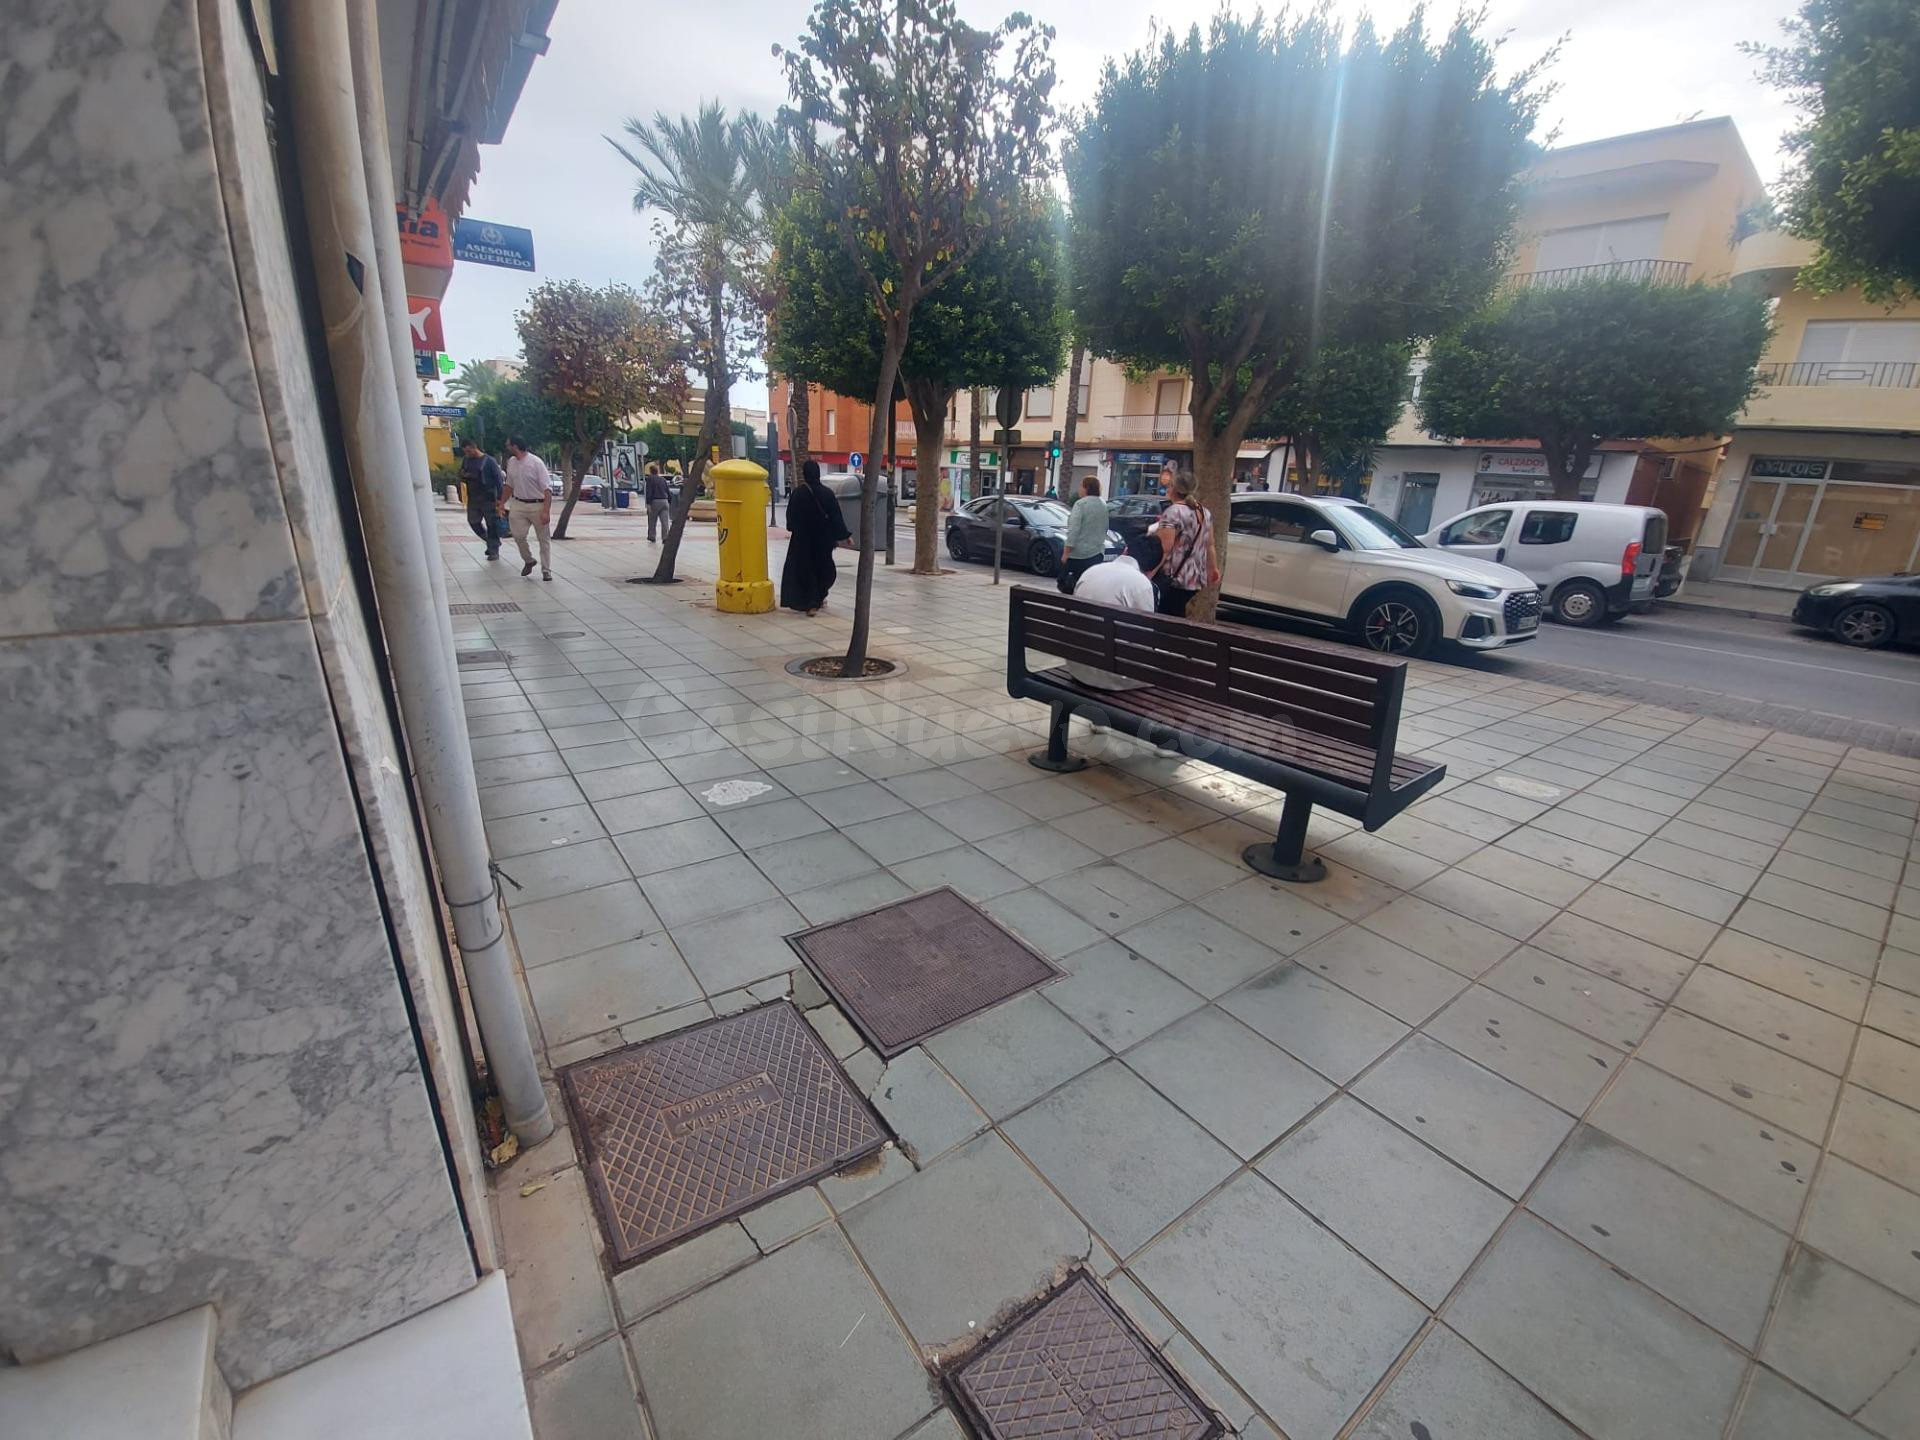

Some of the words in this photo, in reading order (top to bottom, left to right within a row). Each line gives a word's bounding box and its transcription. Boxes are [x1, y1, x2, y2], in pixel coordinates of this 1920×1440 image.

[456, 249, 532, 268] FIGUEREDO
[465, 243, 522, 259] ASESORIA
[1498, 457, 1545, 467] CALZADOS
[670, 1077, 765, 1119] ELECTRICA
[685, 1095, 764, 1132] ENERGIA
